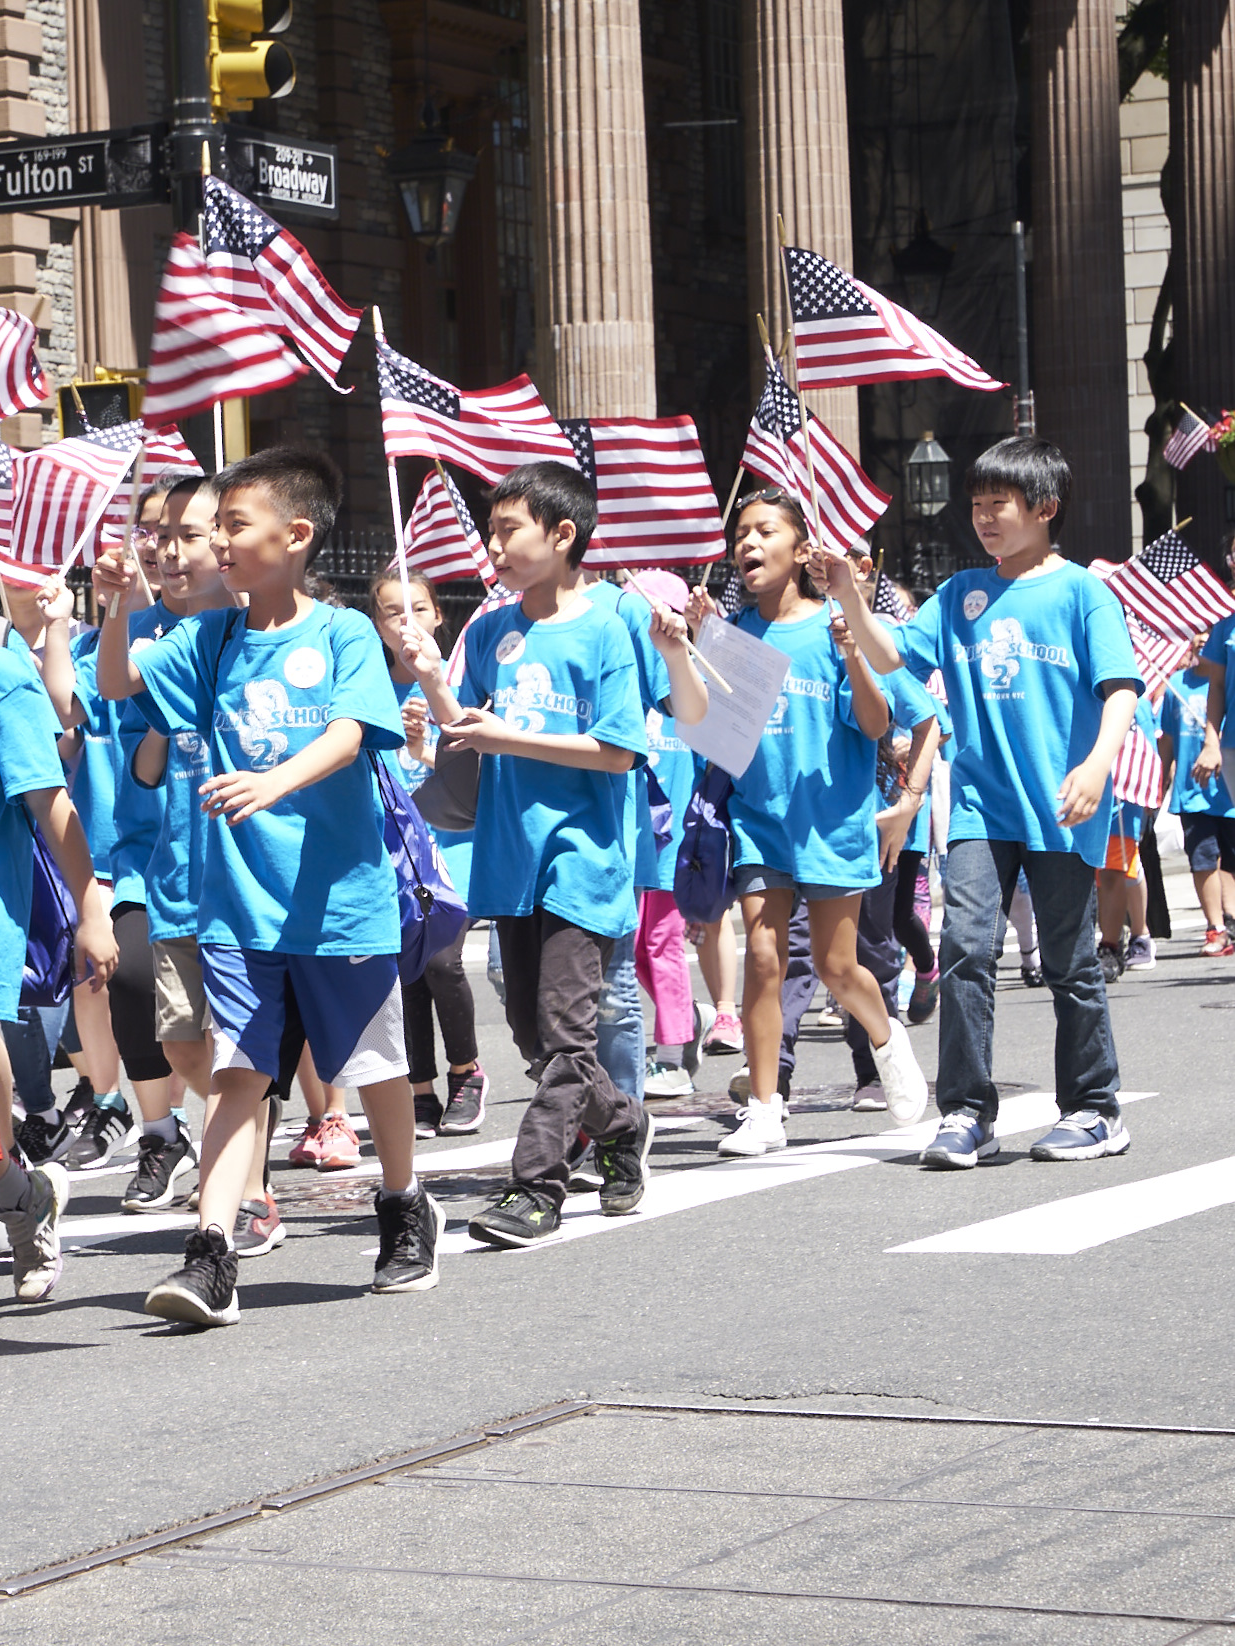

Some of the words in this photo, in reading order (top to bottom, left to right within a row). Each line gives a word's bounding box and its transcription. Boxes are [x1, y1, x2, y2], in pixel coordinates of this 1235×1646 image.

[33, 147, 67, 163] 169-199
[77, 154, 95, 174] ST
[258, 156, 329, 202] Broadway
[1008, 640, 1070, 668] SCHOOL
[989, 664, 1012, 689] 2
[270, 703, 329, 728] SCHOO
[251, 737, 279, 771] 2
